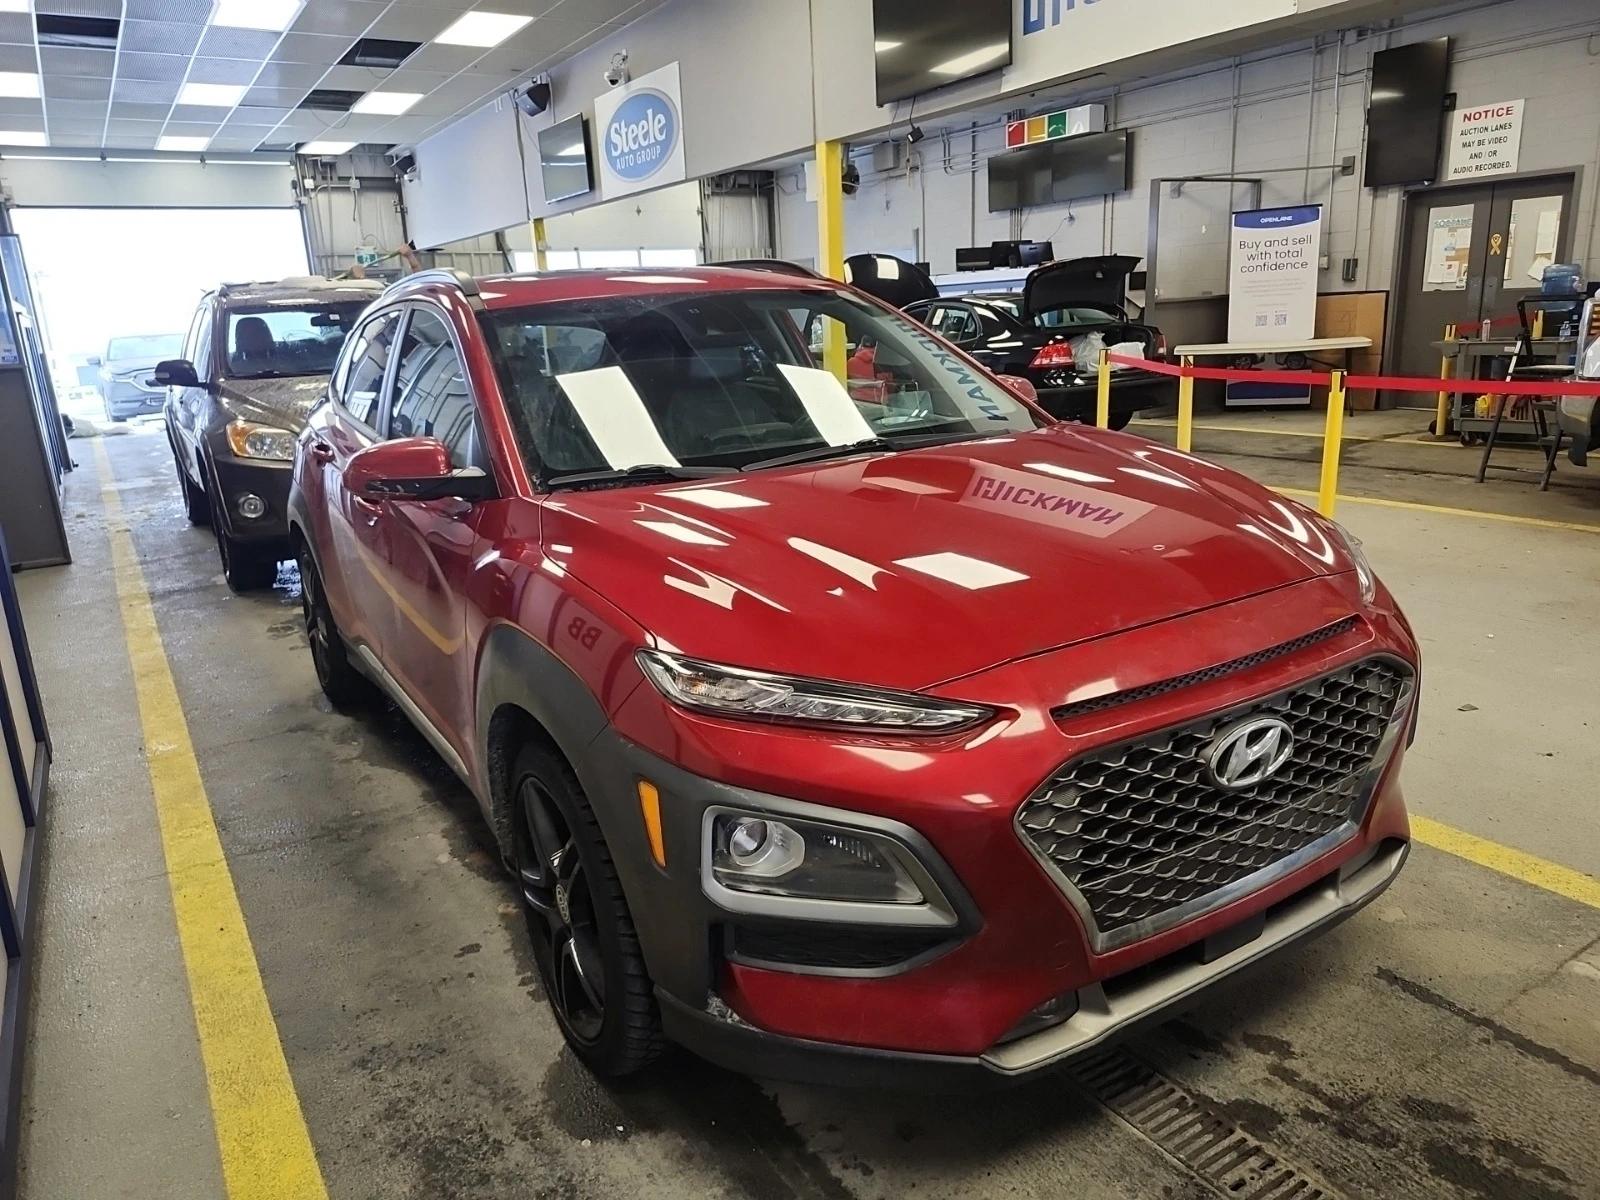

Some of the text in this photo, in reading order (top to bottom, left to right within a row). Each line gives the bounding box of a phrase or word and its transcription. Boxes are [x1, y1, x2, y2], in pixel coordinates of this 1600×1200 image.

[1463, 106, 1514, 122] NOTICE
[610, 108, 667, 157] Steele
[1459, 121, 1513, 136] AUCTION LANES
[1461, 135, 1508, 149] MAY BE VIDEO
[616, 145, 661, 171] AUTO GROUP
[1469, 151, 1483, 160] AND
[1487, 149, 1498, 158] OR
[1452, 160, 1512, 175] AUDIO RECORDED.
[1239, 234, 1312, 252] Buy and sell
[1246, 247, 1303, 261] with total
[1240, 261, 1308, 273] confidence
